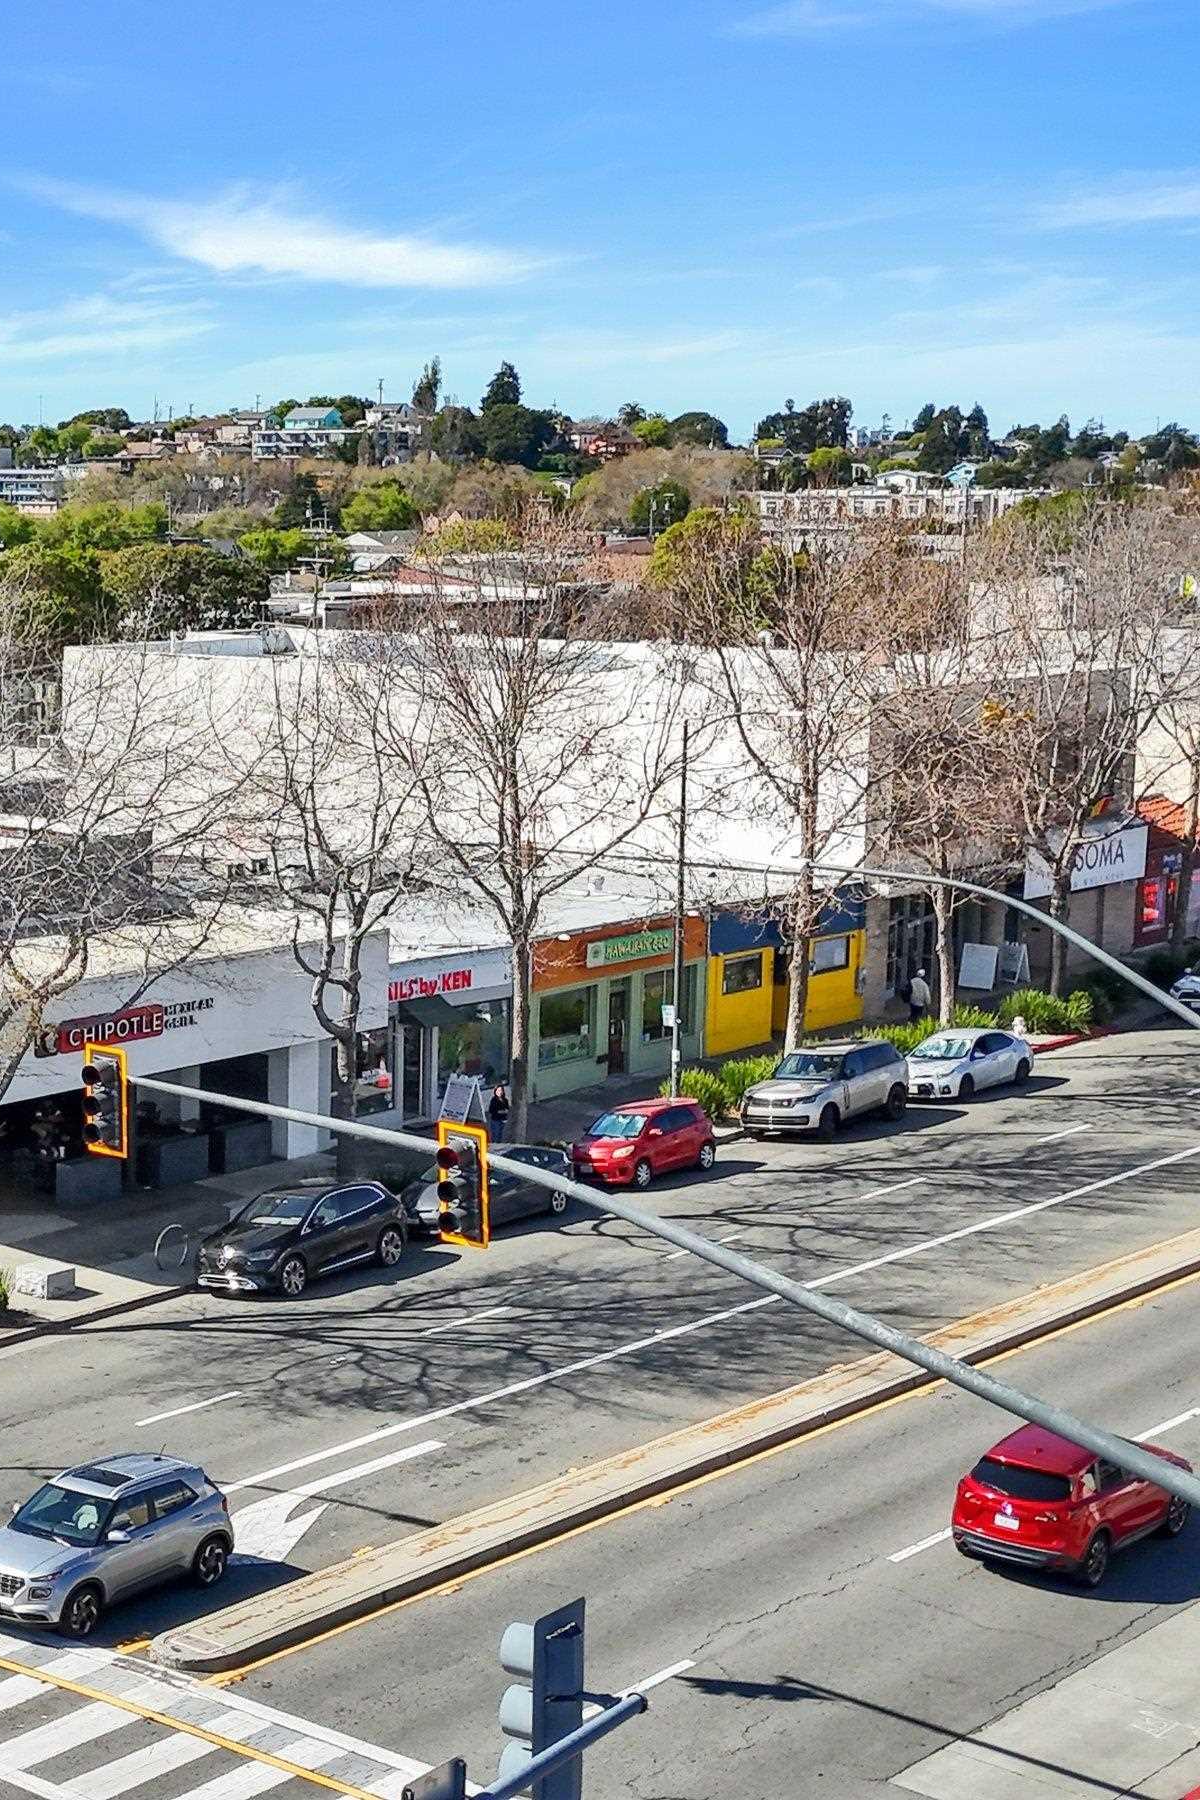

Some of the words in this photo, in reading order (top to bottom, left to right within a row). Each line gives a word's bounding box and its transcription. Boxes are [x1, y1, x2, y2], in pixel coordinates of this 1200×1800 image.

[1074, 839, 1125, 872] SOMA
[419, 976, 438, 998] by
[441, 968, 473, 992] KEN
[69, 1013, 163, 1046] CHIPOTLE
